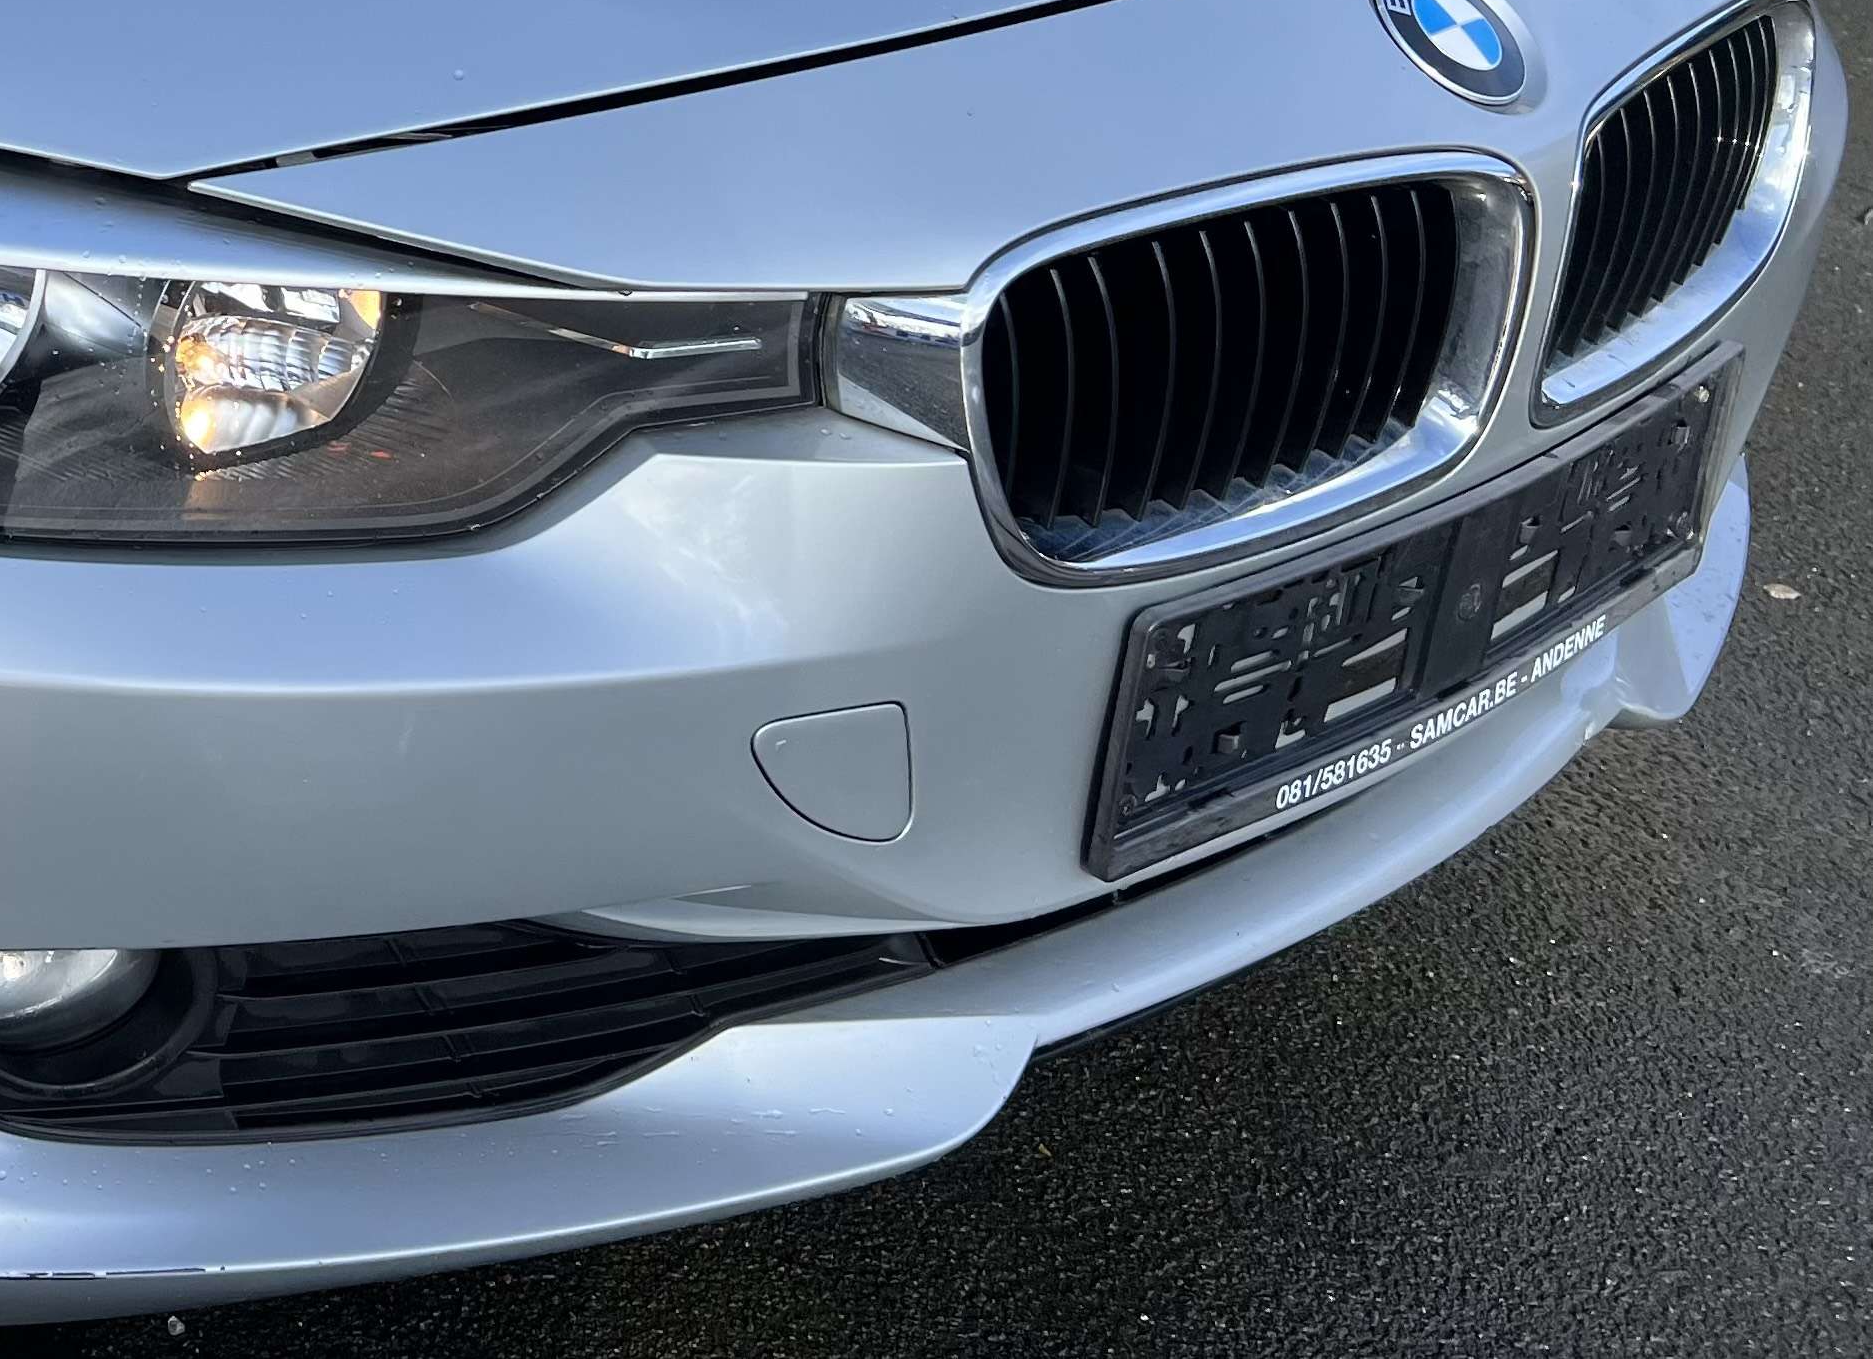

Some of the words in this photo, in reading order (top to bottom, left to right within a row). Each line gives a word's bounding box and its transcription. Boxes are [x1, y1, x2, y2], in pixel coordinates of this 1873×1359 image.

[1276, 738, 1392, 809] 081/581635
[1409, 671, 1518, 750] SAMCAR.BE
[1530, 614, 1607, 683] ANDENNE
